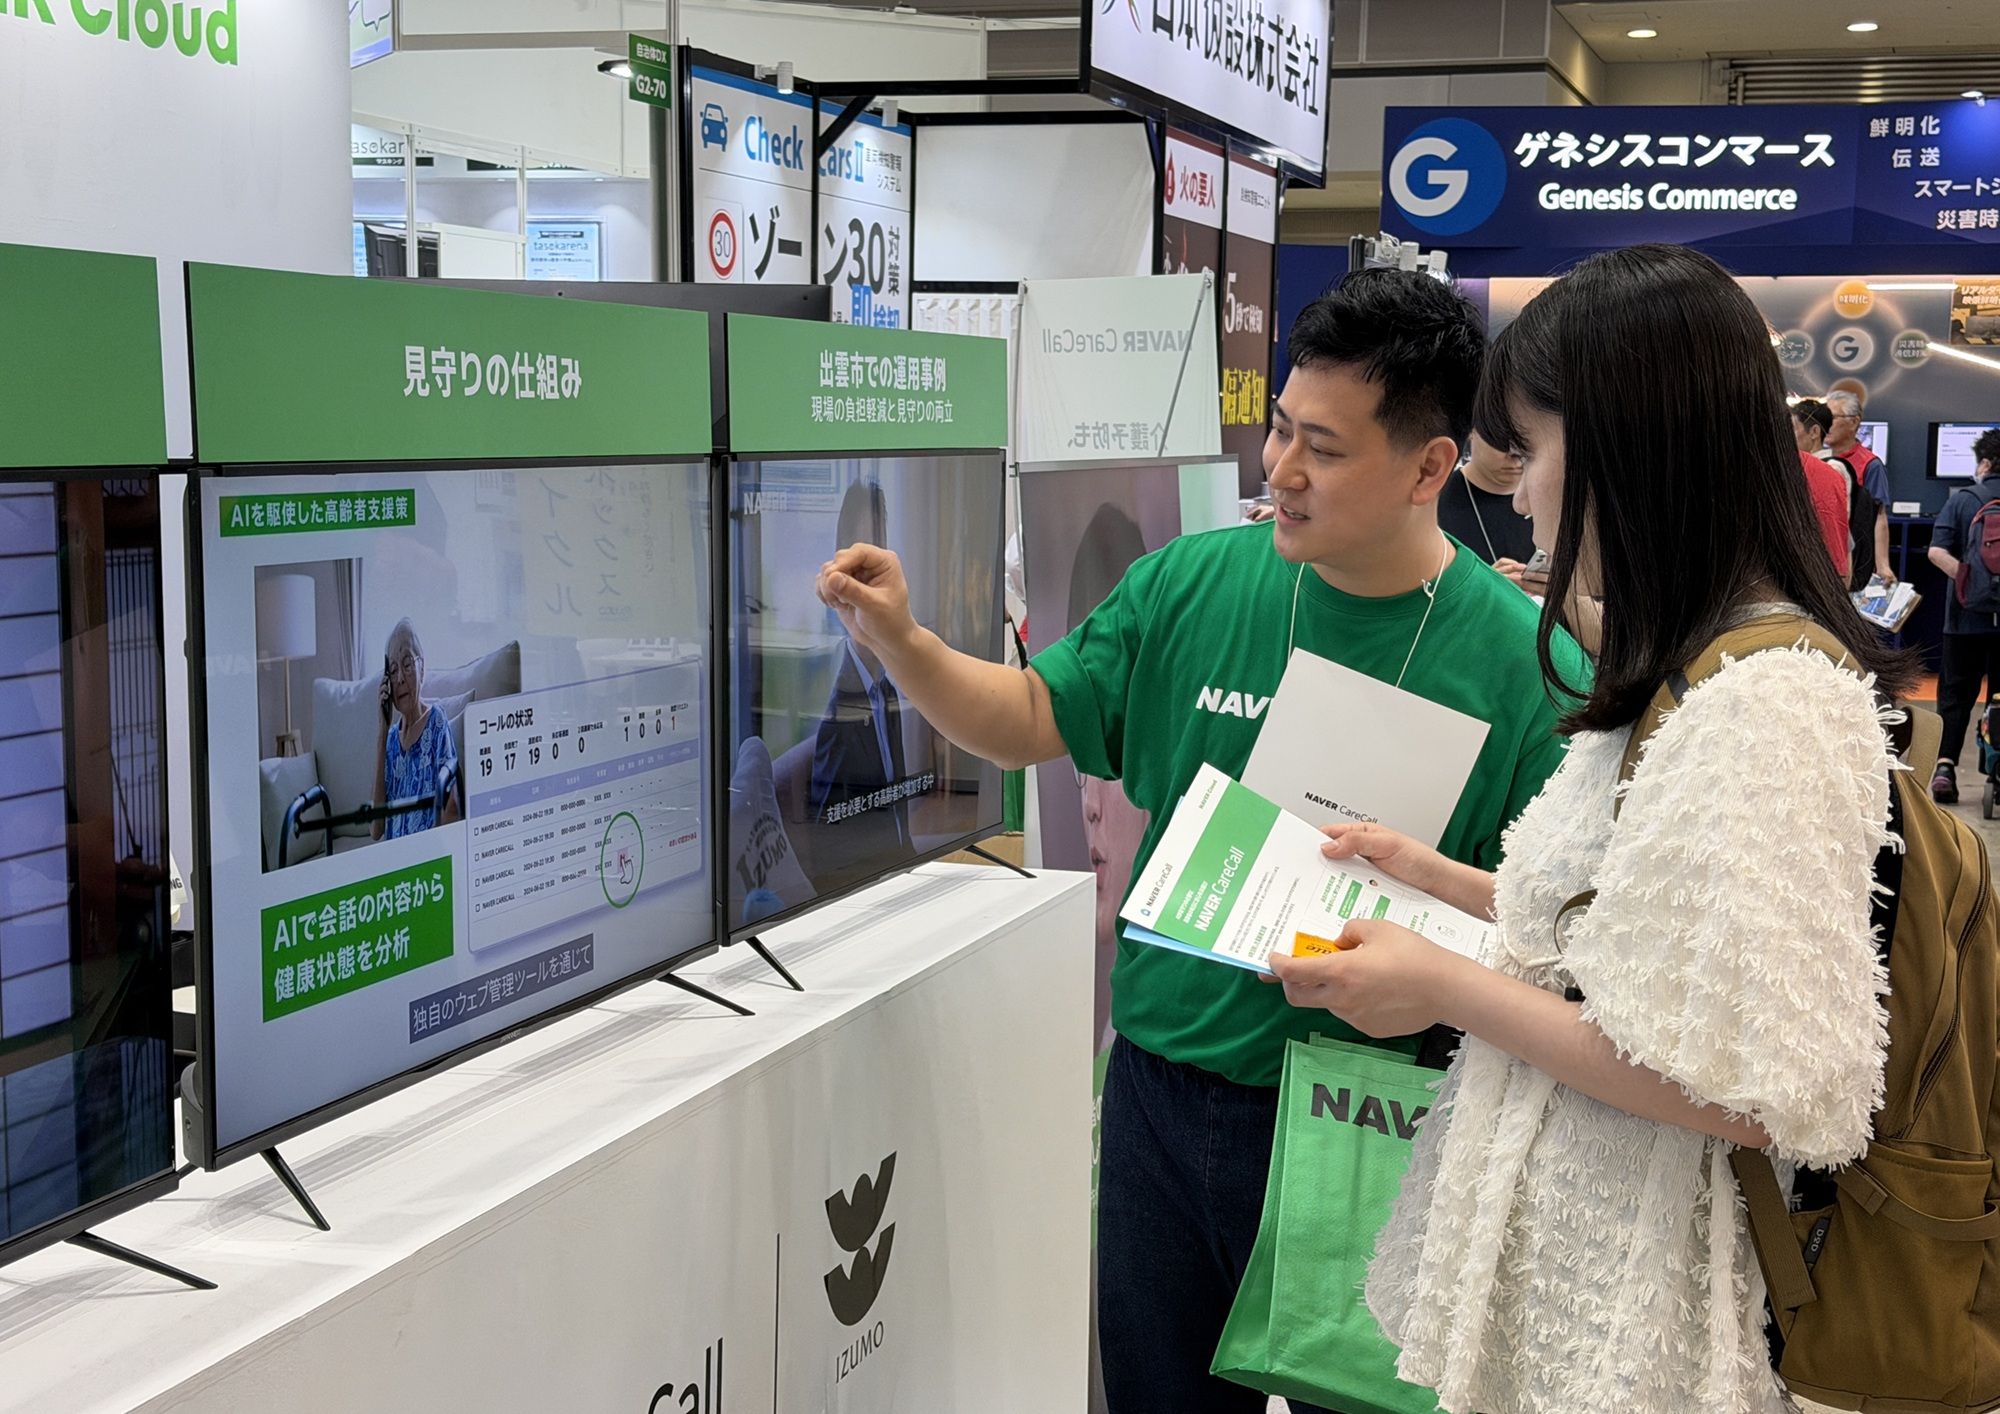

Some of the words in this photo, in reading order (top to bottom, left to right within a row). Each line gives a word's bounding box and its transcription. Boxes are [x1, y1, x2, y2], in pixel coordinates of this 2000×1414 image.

[636, 74, 667, 99] G2-70
[744, 115, 804, 171] Check
[1513, 131, 1836, 168] ゲネシスコンマース
[1538, 182, 1644, 211] Genesis
[1647, 182, 1798, 211] Commerce
[714, 229, 731, 258] 30
[403, 345, 582, 400] 見守りの仕組み
[819, 349, 947, 392] 出雲市での運用事例
[811, 396, 953, 423] 現場の負担軽減と見守りの両立
[231, 496, 408, 528] AIを駆使した高齢者支援策
[479, 707, 534, 735] コールの状況
[1195, 685, 1275, 719] NAV
[480, 758, 492, 777] 19
[505, 752, 516, 771] 17
[528, 747, 540, 765] 19
[552, 742, 559, 760] 0
[578, 736, 585, 753] 0
[624, 726, 629, 742] 1
[639, 722, 645, 738] 0
[655, 718, 661, 735] 0
[1305, 791, 1338, 811] NAVER
[1194, 893, 1222, 932] NAVER
[1211, 845, 1245, 895] CareCall
[273, 873, 444, 952] AIで会話の内容から
[274, 926, 411, 1003] 健康状態を分析
[413, 943, 591, 1035] 独自のウェブ管理ツールを通じて
[836, 1320, 884, 1383] IZUMO
